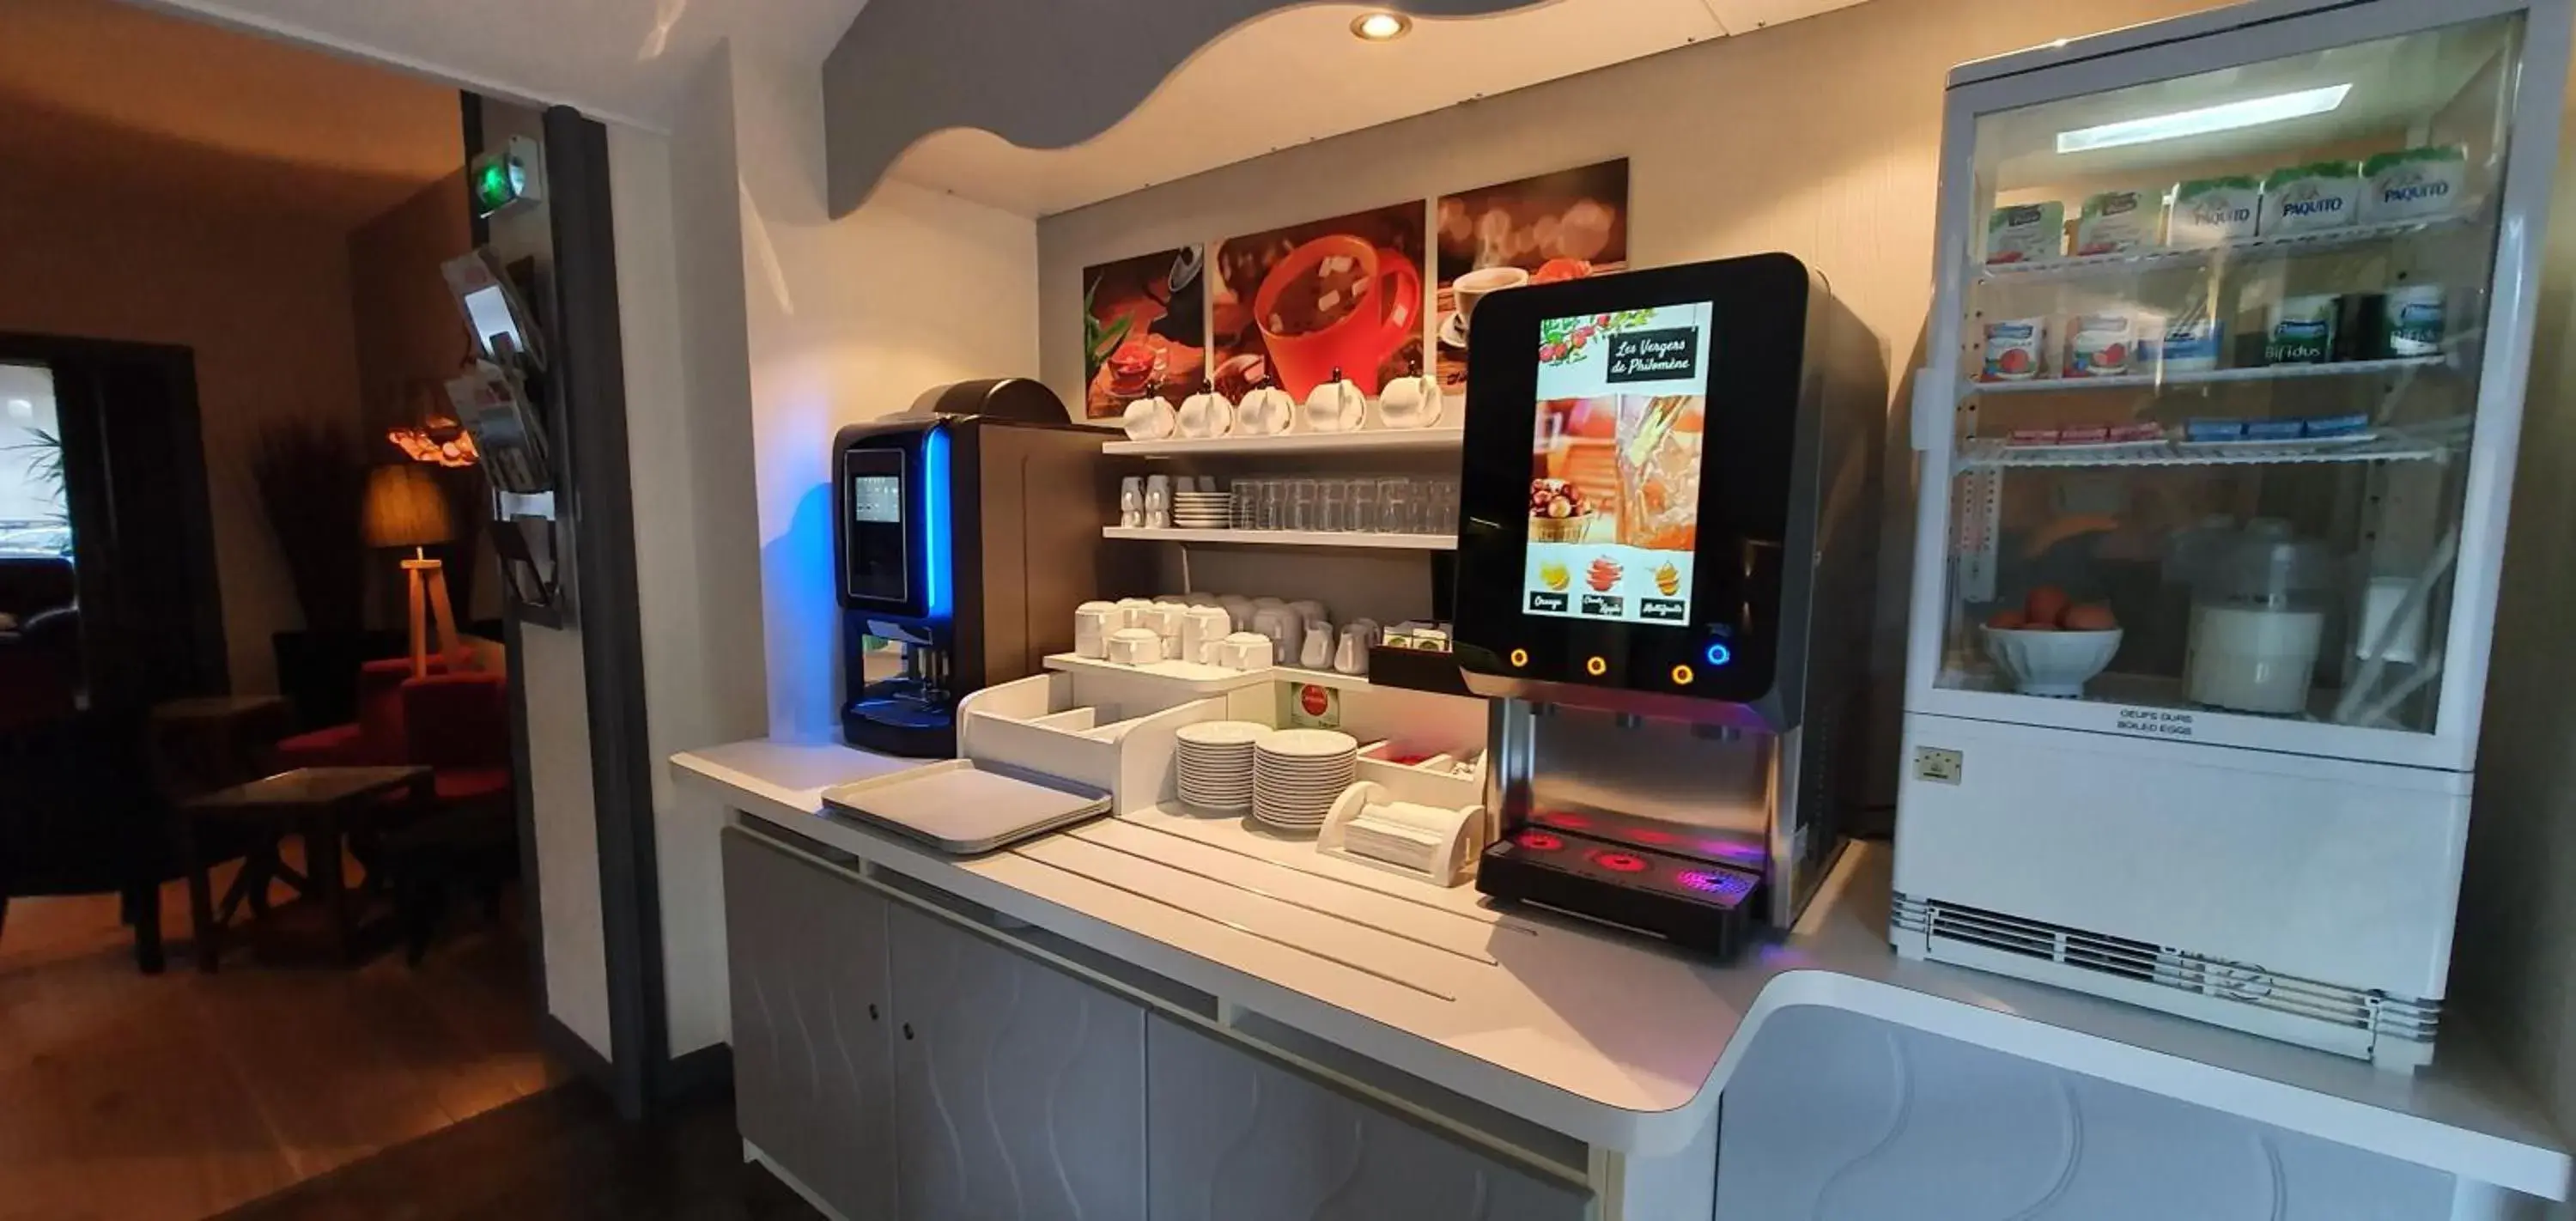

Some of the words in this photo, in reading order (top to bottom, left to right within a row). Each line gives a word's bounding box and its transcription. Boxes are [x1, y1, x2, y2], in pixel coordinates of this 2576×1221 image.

[2384, 181, 2449, 203] PAQUITO
[2282, 197, 2343, 216] PAQUITO
[1615, 341, 1636, 356] Les
[1640, 338, 1685, 358] Vergers
[2265, 346, 2321, 361] Bifidus
[1611, 360, 1626, 374] de
